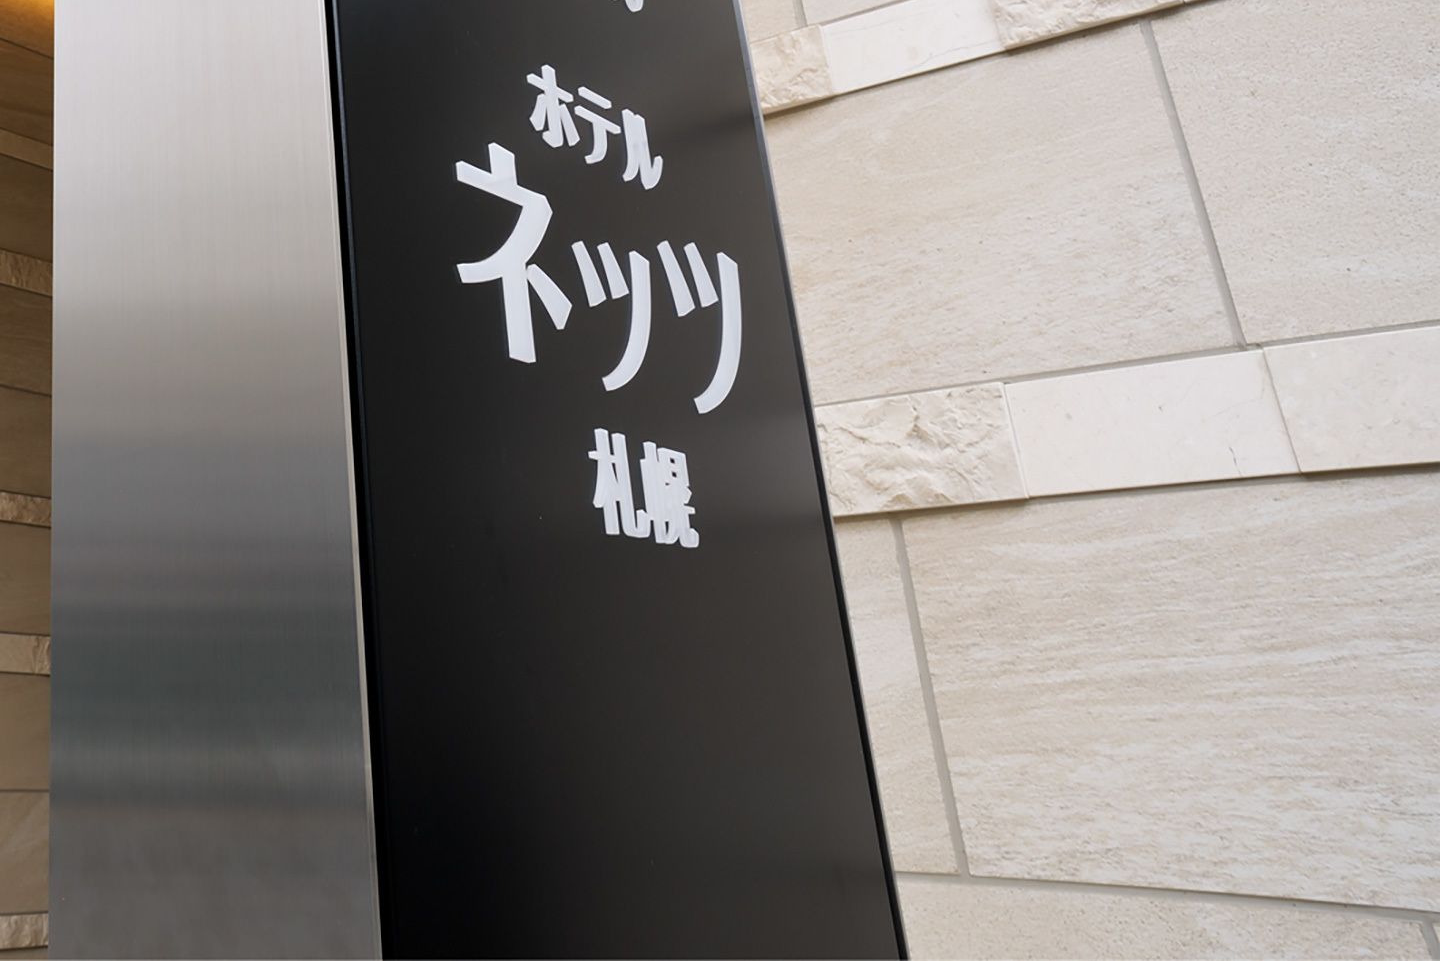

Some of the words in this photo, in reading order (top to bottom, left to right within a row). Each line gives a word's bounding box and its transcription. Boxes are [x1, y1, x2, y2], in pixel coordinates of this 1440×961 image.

[526, 64, 663, 190] ホテル
[588, 428, 700, 548] 札幌
